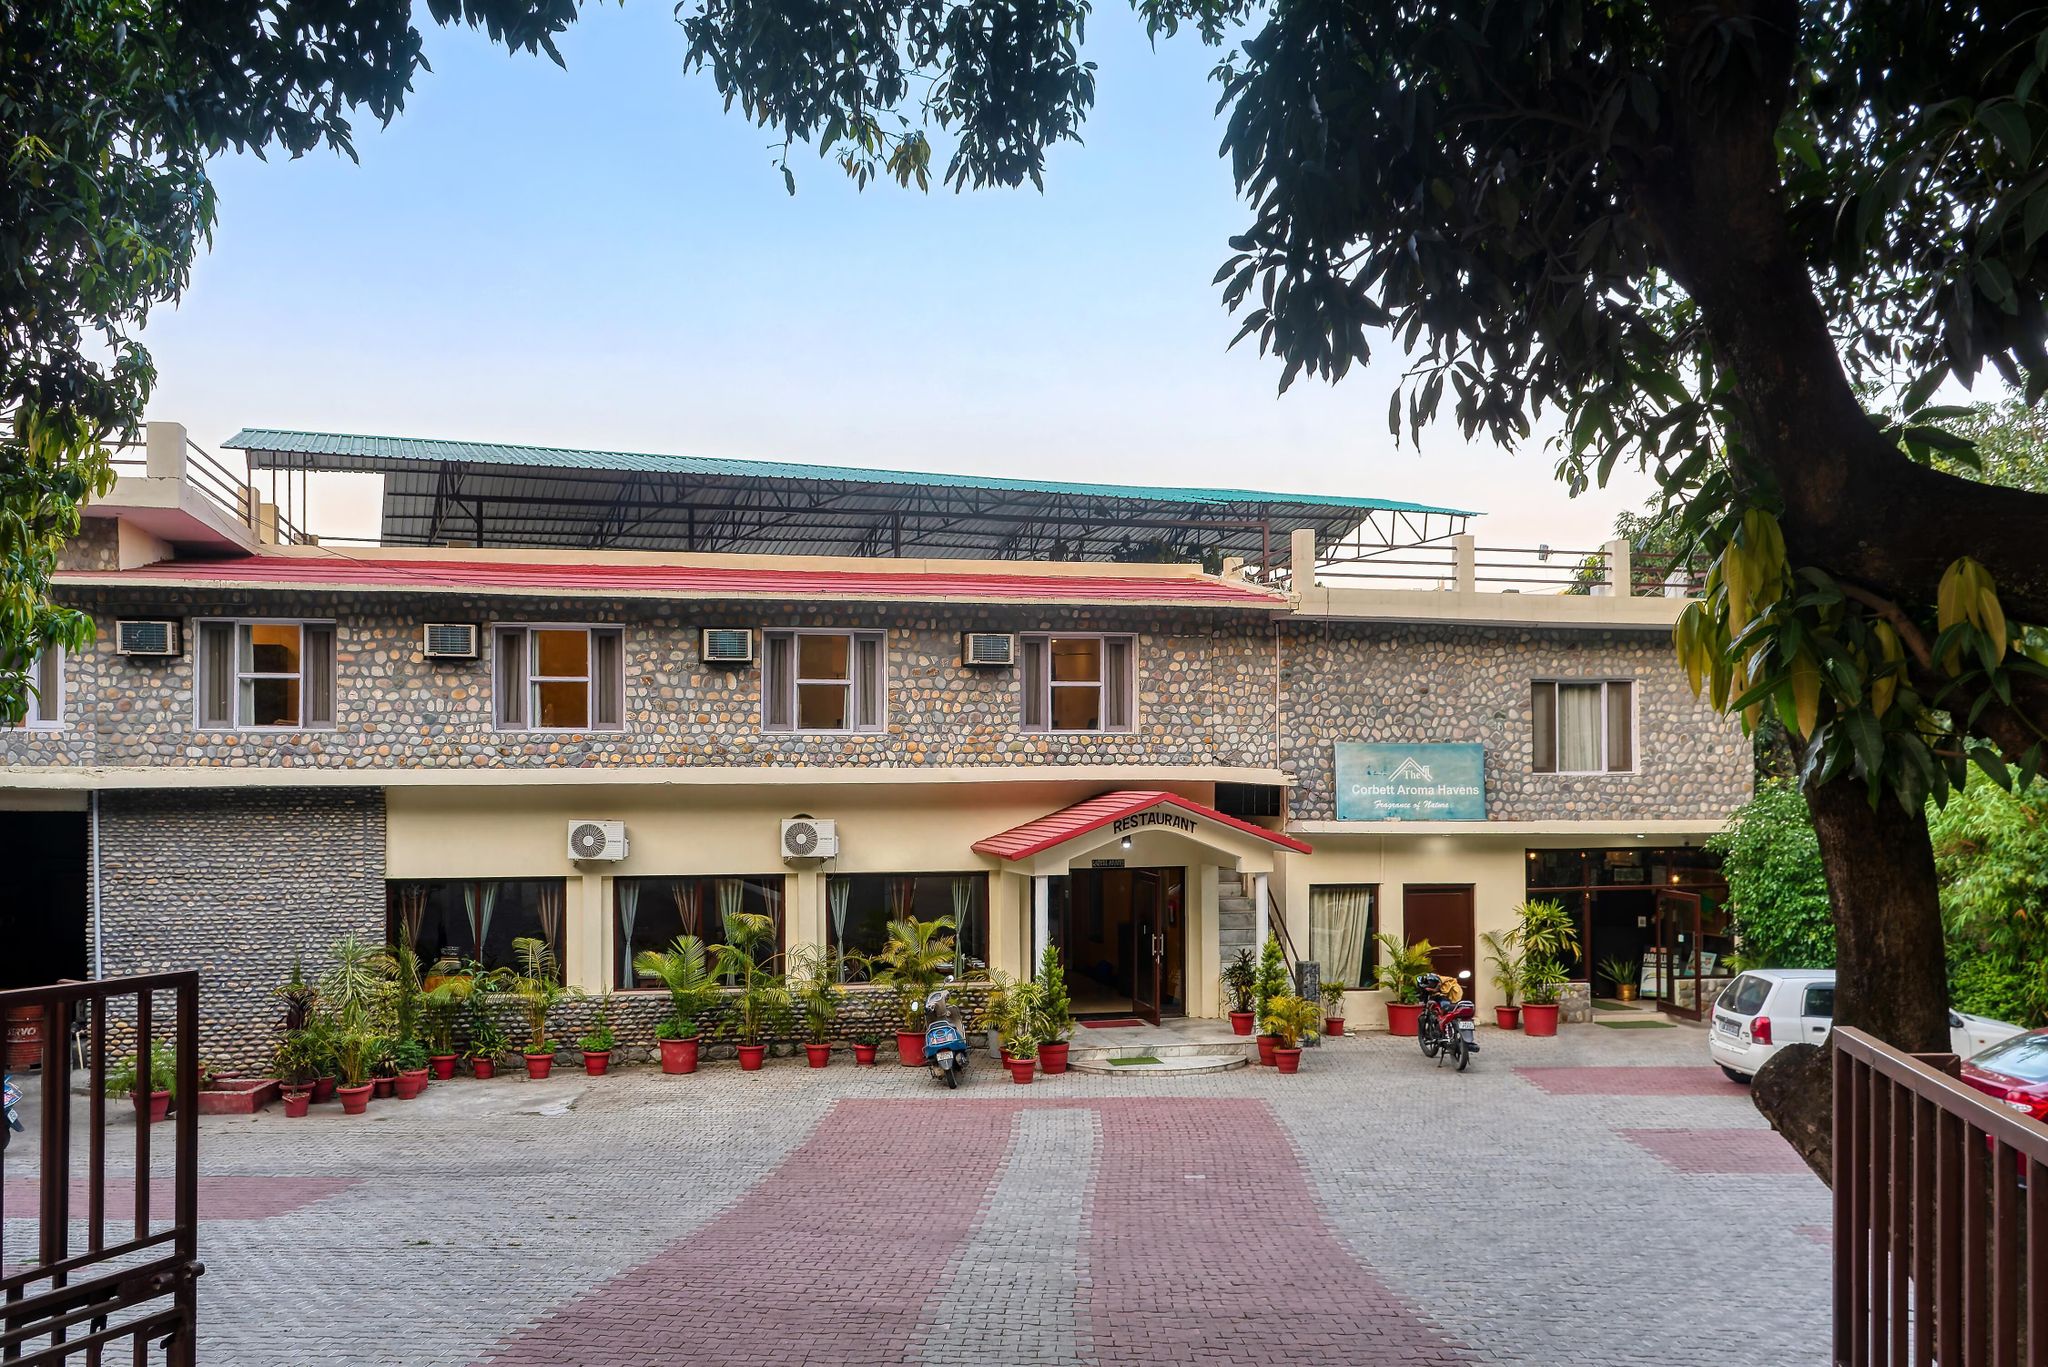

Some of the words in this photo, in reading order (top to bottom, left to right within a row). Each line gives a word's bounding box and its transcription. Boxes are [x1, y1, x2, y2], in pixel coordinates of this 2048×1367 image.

[1404, 769, 1421, 780] The
[1351, 784, 1395, 796] Corbett
[1396, 784, 1435, 796] Aroma
[1437, 784, 1480, 796] Havens
[1373, 799, 1411, 811] Fragrance
[1412, 799, 1421, 811] of
[1423, 799, 1449, 810] Nature
[1113, 812, 1198, 835] RESTAURANT
